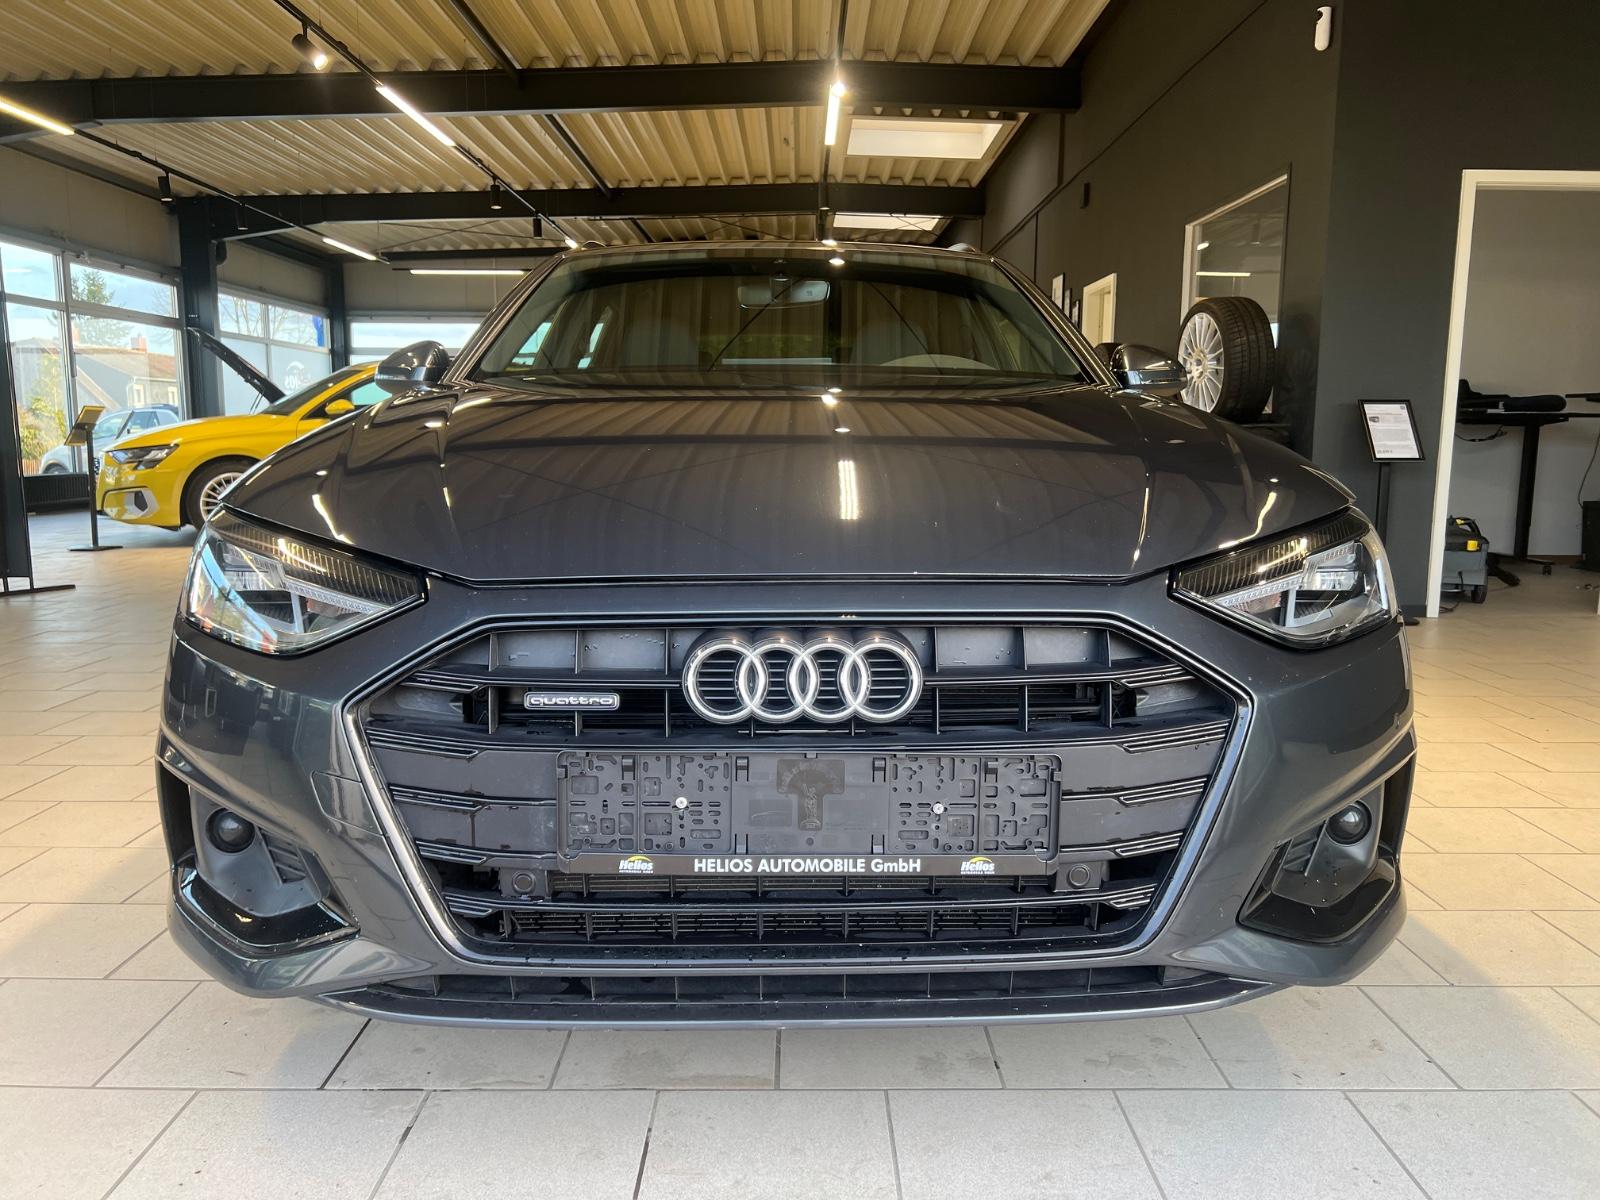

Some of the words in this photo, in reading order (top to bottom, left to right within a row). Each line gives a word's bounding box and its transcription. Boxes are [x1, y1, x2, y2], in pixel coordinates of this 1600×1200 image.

[529, 695, 614, 707] quattro
[618, 859, 654, 871] Helios
[693, 858, 753, 873] HELIOS
[757, 858, 866, 873] AUTOMOBILE
[870, 857, 921, 873] GmbH
[960, 860, 995, 871] Helios
